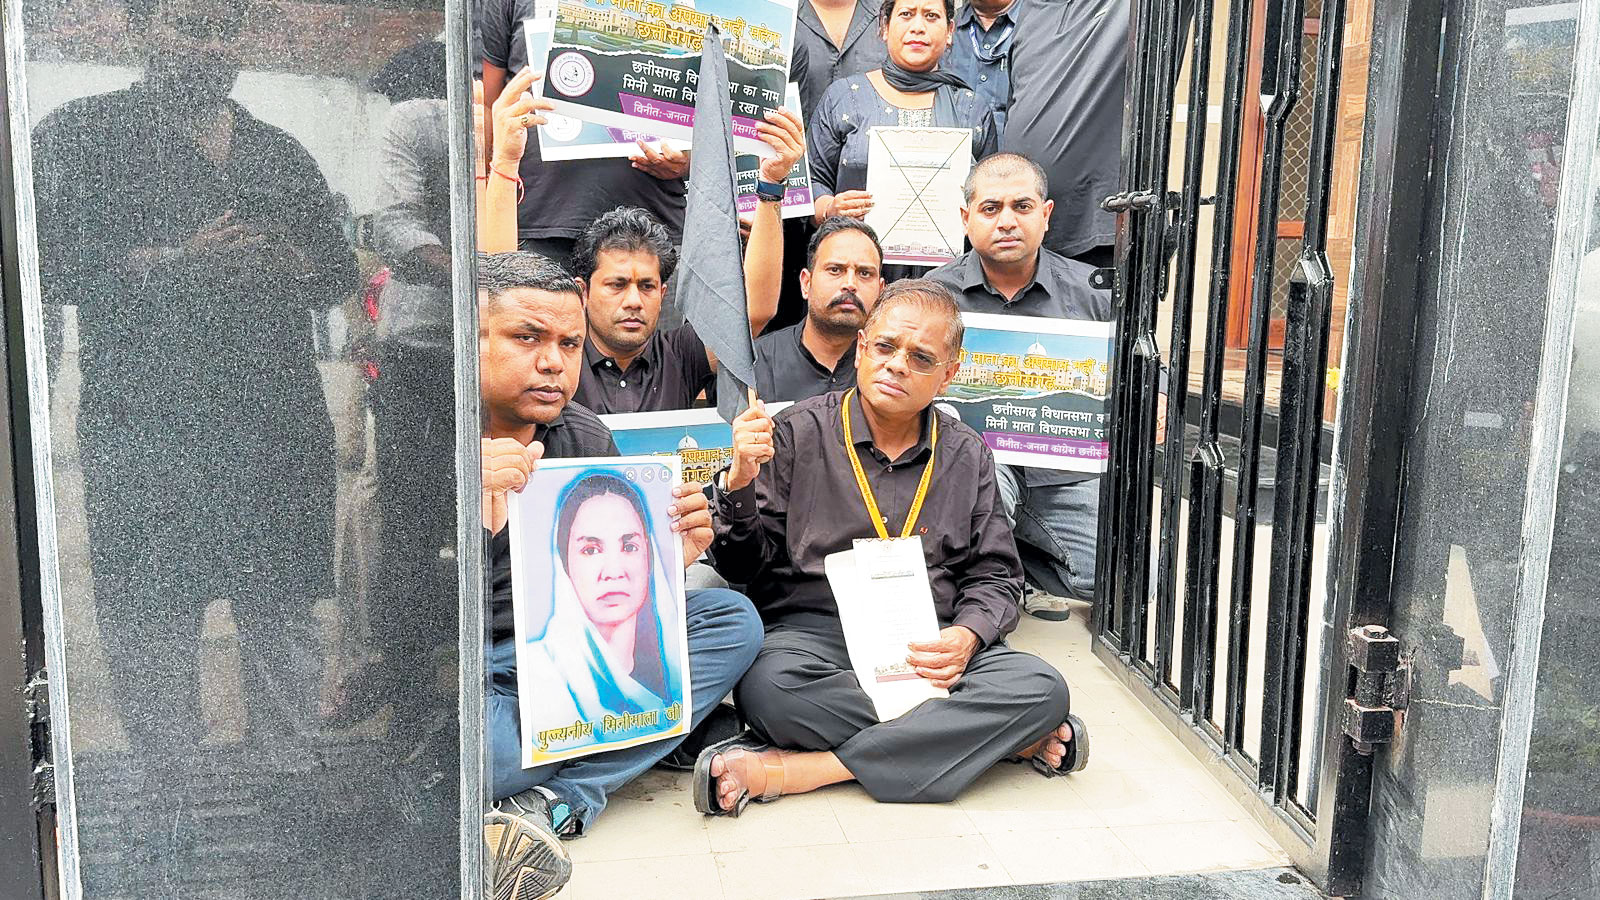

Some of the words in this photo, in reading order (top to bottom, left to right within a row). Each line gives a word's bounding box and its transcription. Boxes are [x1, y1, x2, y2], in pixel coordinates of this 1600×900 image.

[632, 60, 682, 84] छत्तीसगढ़
[743, 84, 758, 97] का
[762, 89, 780, 103] नाम
[623, 74, 648, 93] मिनी
[653, 83, 678, 99] माता
[738, 101, 759, 115] रखा
[789, 176, 807, 187] जाए
[971, 351, 1000, 366] माता
[1001, 354, 1020, 368] का
[1023, 356, 1070, 372] अपमान
[992, 402, 1037, 419] छत्तीसगढ़
[1041, 405, 1093, 423] विधानसभा
[985, 415, 1008, 430] मिनी
[1012, 420, 1035, 433] माता
[1039, 421, 1091, 438] विधानसभा
[602, 711, 659, 734] मिनीमाता
